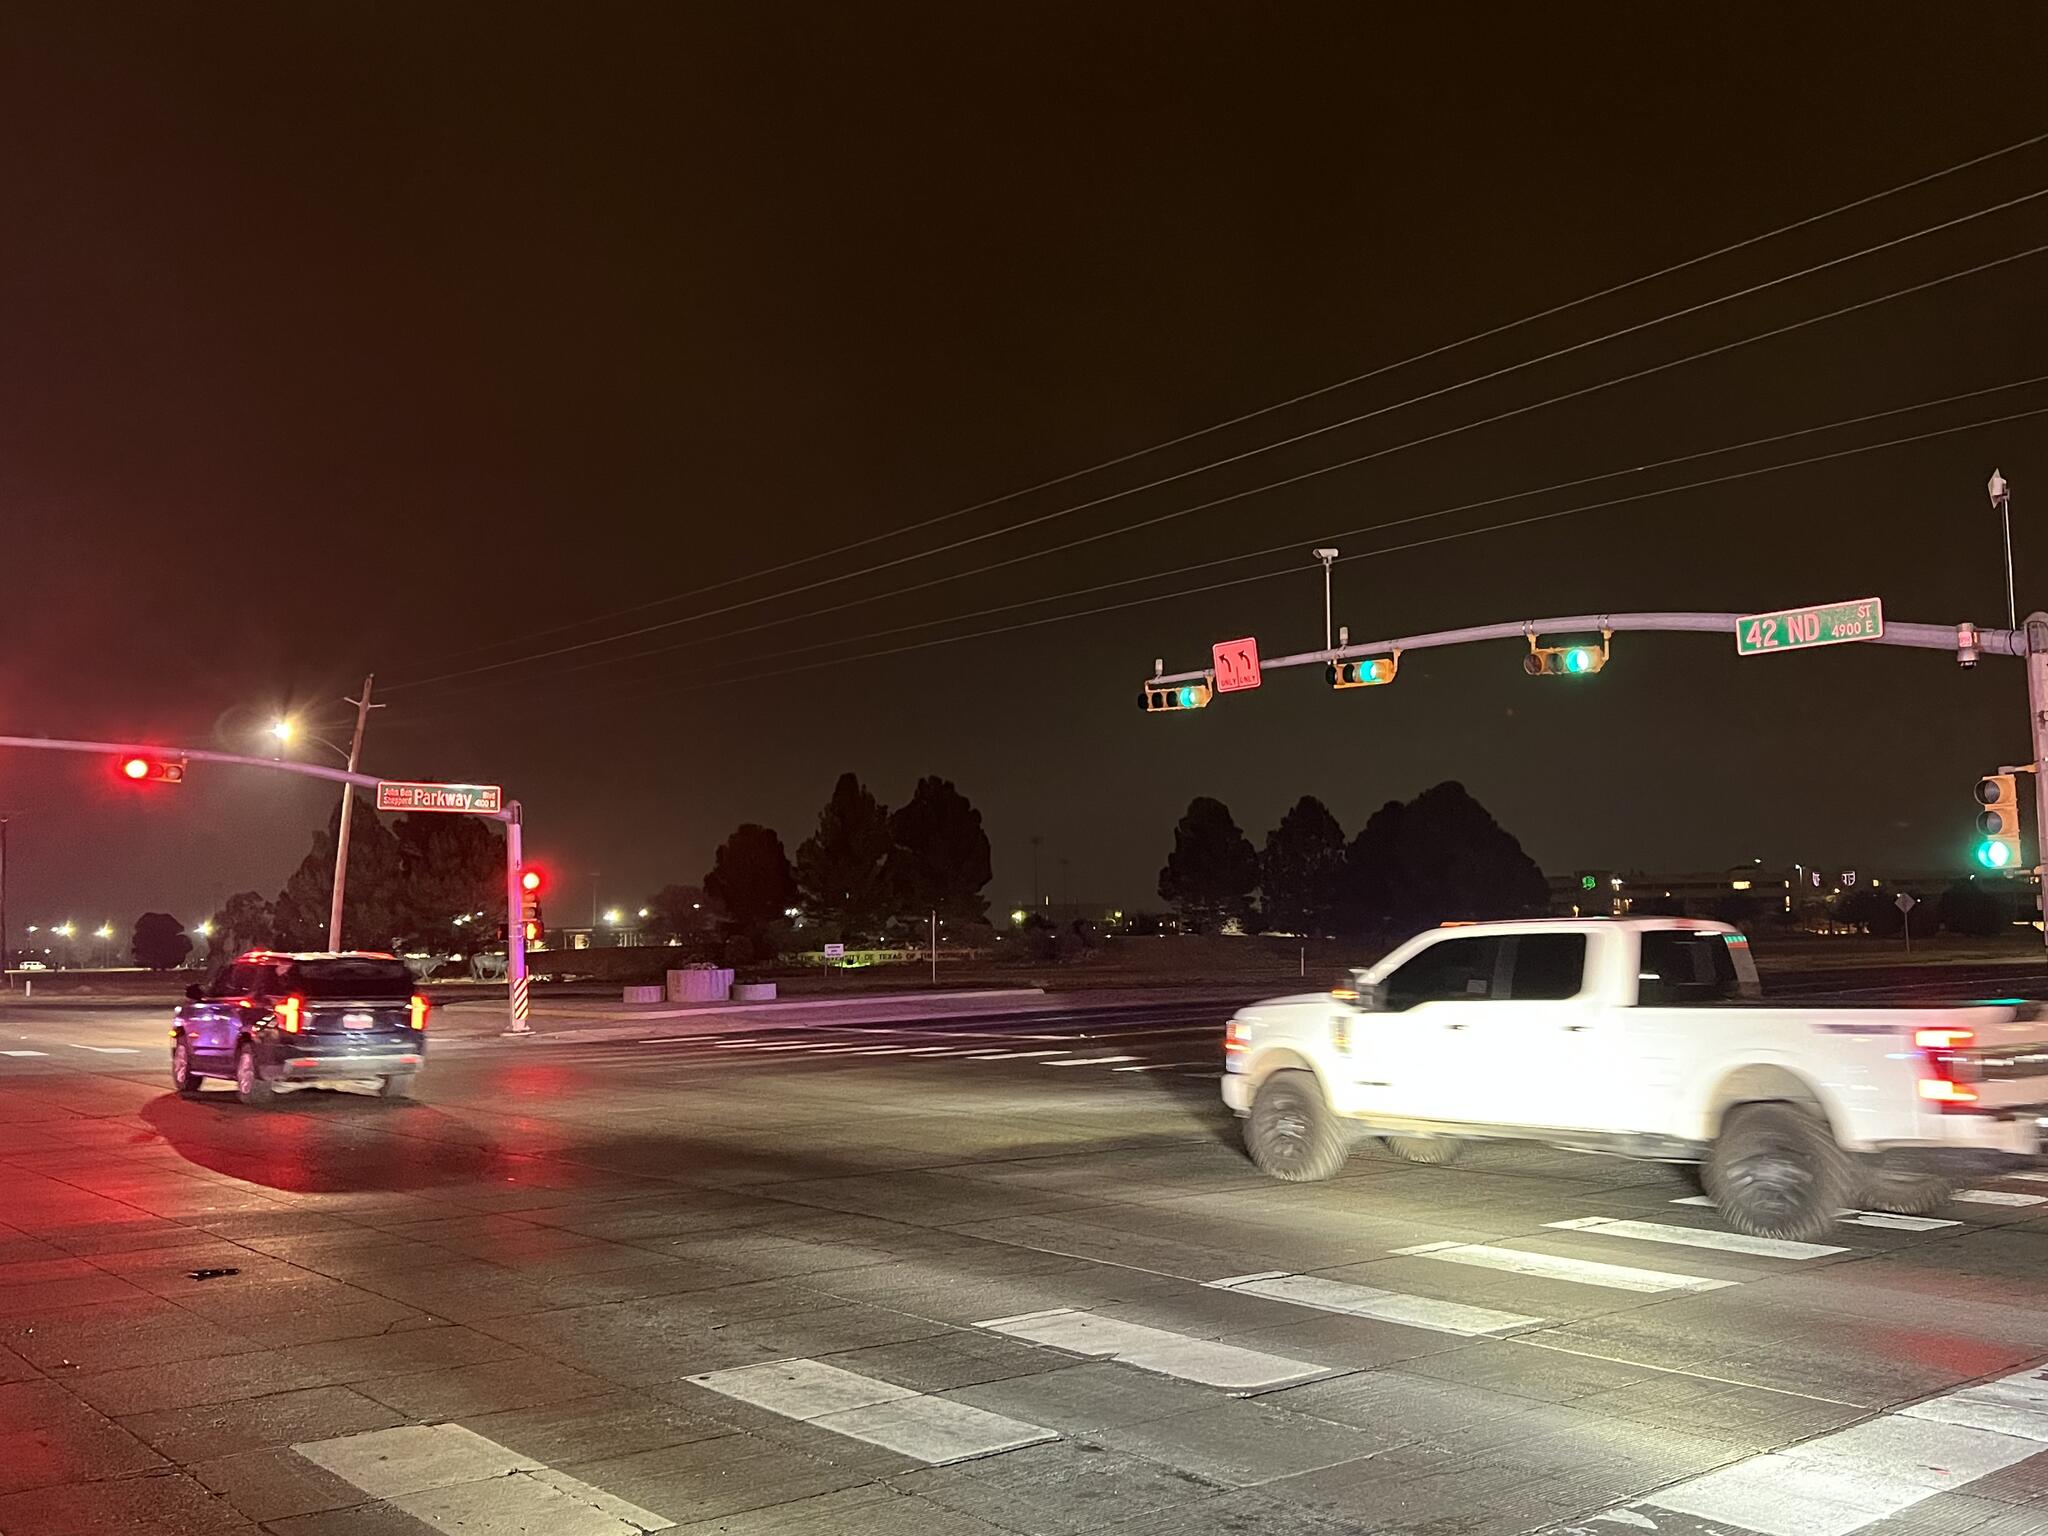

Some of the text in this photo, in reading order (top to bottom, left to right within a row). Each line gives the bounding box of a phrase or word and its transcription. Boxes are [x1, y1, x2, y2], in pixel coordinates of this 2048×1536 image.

[1857, 604, 1871, 618] ST
[1746, 613, 1820, 648] 42 ND
[1831, 620, 1873, 637] 4900 E
[414, 789, 472, 809] Parkway
[879, 952, 903, 960] TEXAS
